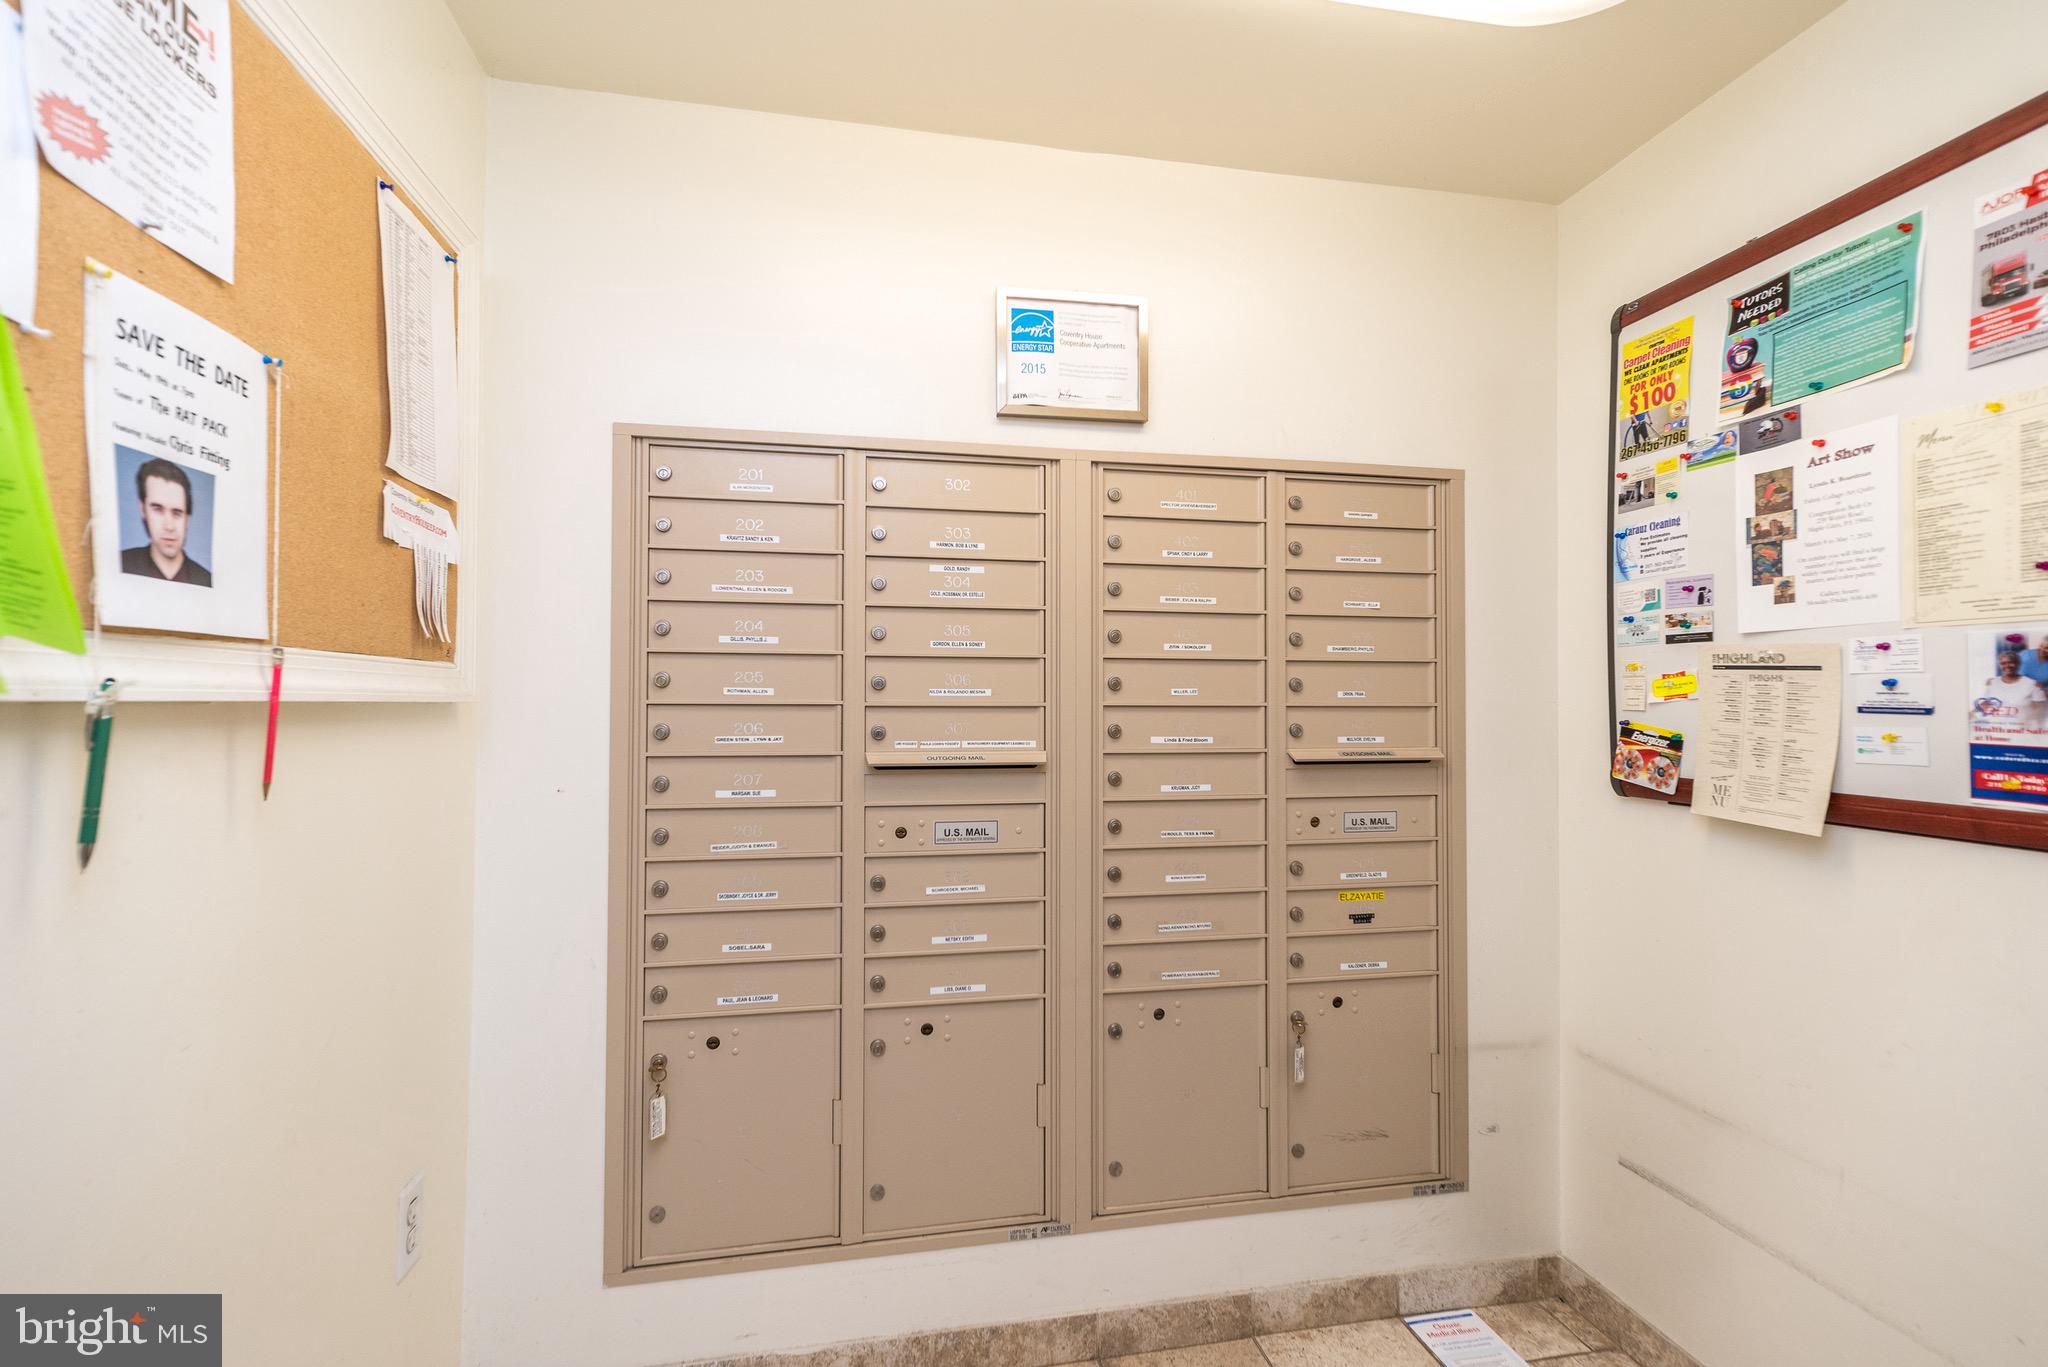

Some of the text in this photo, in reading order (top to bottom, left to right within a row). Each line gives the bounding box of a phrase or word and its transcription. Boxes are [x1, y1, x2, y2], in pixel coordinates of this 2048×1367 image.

[164, 20, 199, 63] OUR
[141, 17, 217, 99] LOCKERS
[1740, 282, 1784, 309] TUTORS
[1737, 297, 1782, 323] NEEDED
[1059, 330, 1103, 341] Coventry House
[1013, 344, 1054, 353] ENERGY STAR
[1059, 339, 1126, 350] Cooperative Apartments
[116, 317, 248, 398] SAVE THE DATE
[1624, 351, 1650, 369] Carpet
[1652, 336, 1691, 358] Cleaning
[1020, 362, 1047, 375] 2015
[1624, 347, 1688, 377] WE CLEAN APARTMENTS
[1668, 356, 1686, 368] ROOMS
[1630, 369, 1674, 395] FOR ONLY
[1630, 382, 1676, 415] $100
[175, 406, 197, 425] RAT
[201, 417, 229, 438] PACK
[1807, 443, 1875, 468] Art Show
[738, 468, 764, 481] 201
[945, 479, 971, 491] 302
[736, 518, 764, 531] 202
[1649, 516, 1681, 532] Cleaning
[944, 527, 971, 539] 303
[736, 569, 764, 582] 203
[943, 576, 971, 588] 304
[735, 620, 763, 633] 204
[943, 625, 971, 637] 305
[1716, 652, 1785, 664] HIGHLAND
[735, 671, 764, 684] 205
[734, 722, 764, 735] 206
[1631, 731, 1671, 749] Energizer
[734, 774, 763, 786] 207
[1712, 783, 1732, 798] ME
[1351, 817, 1390, 826] U.S. MAIL
[944, 827, 990, 837] U.S. MAIL
